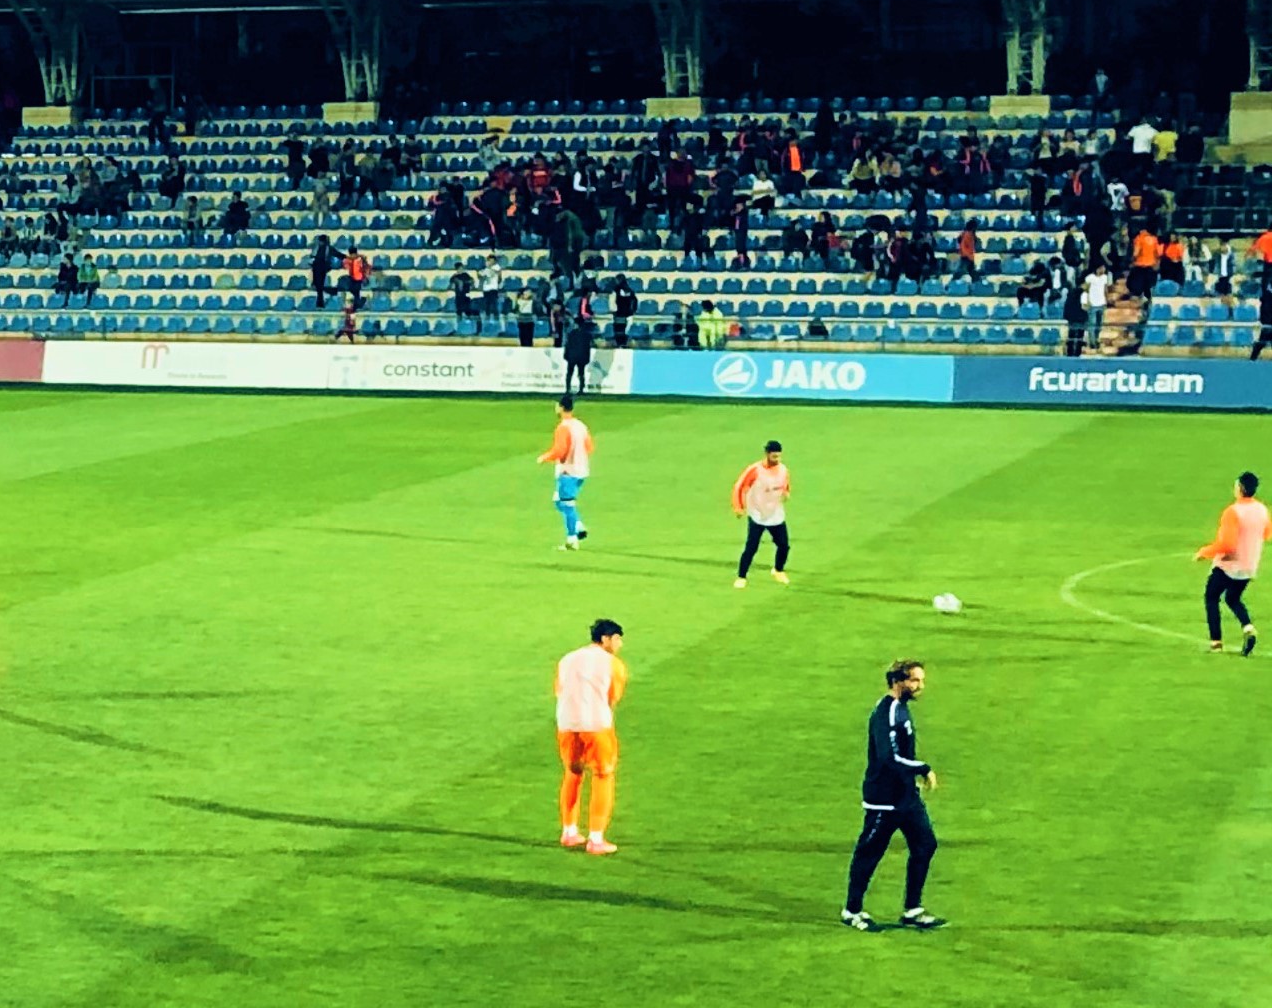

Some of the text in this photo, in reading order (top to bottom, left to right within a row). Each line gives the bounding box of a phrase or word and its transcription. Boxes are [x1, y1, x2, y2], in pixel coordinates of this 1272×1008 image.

[383, 361, 474, 378] constant
[765, 359, 867, 391] JAKO
[1029, 367, 1204, 394] fcurartu.am
